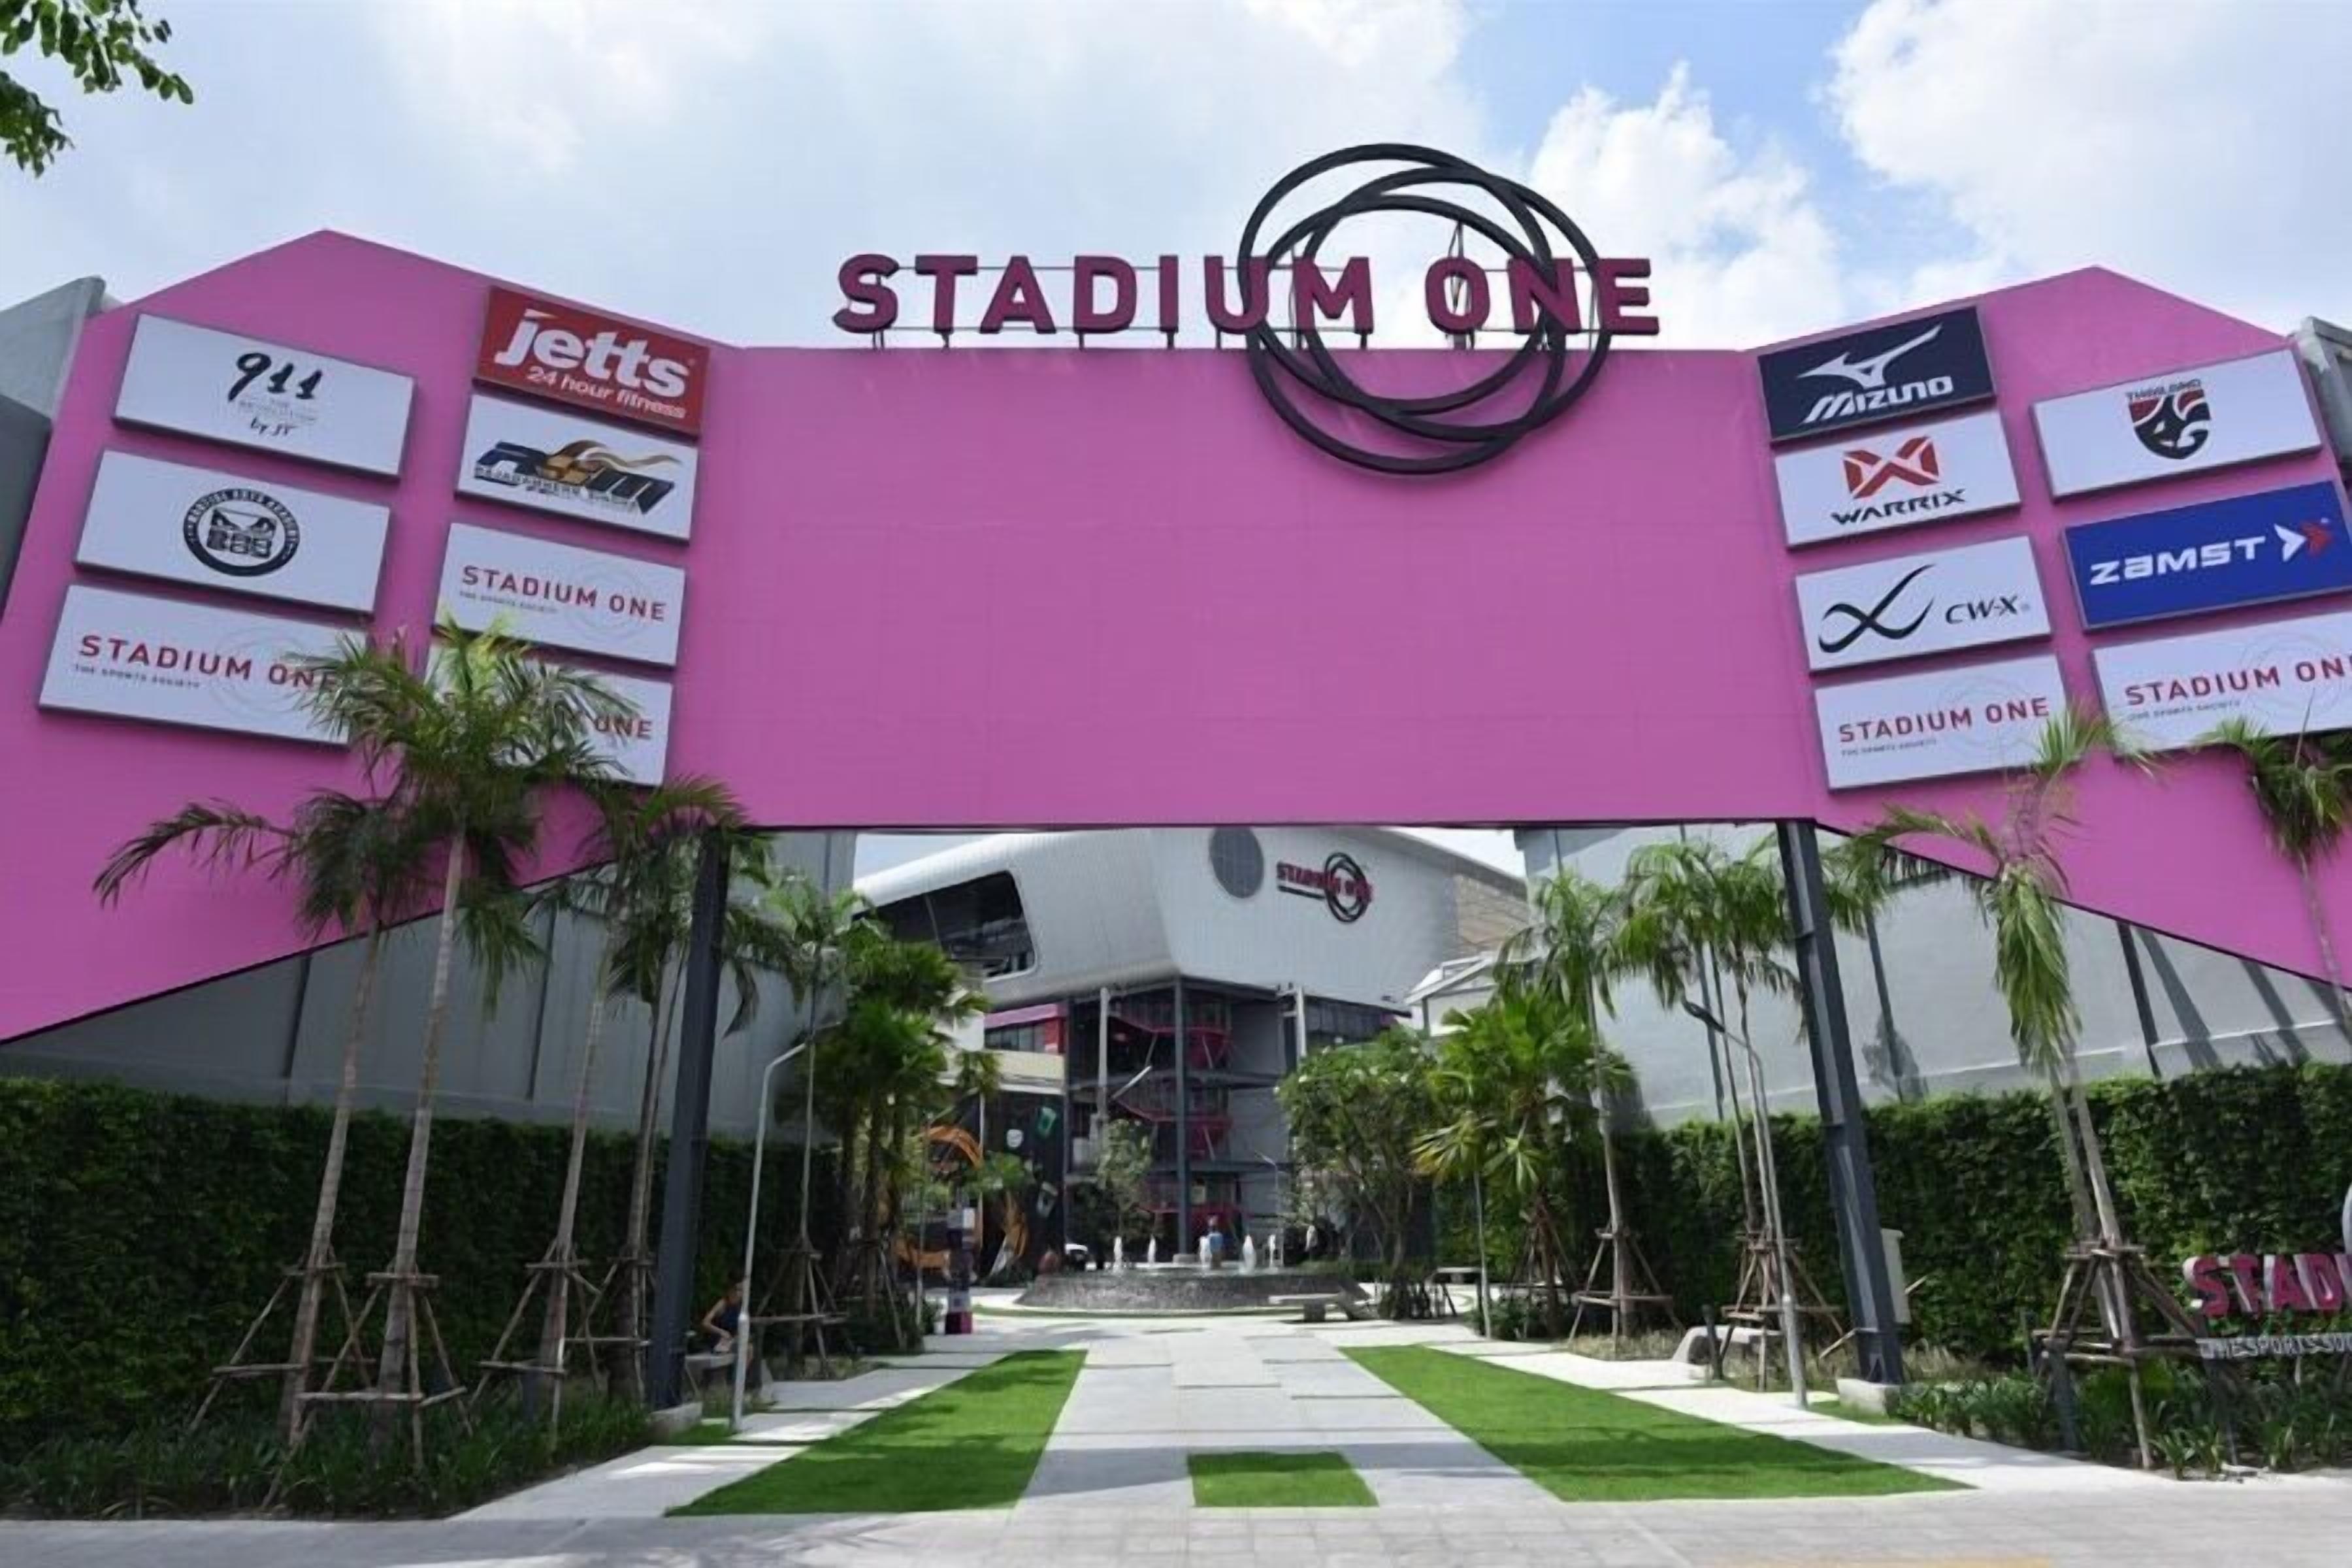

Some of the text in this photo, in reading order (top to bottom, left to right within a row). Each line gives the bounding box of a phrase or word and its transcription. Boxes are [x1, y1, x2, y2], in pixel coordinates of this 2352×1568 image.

[832, 253, 1659, 335] STADIUM ONE
[228, 352, 323, 402] 911
[495, 308, 689, 397] jetts
[526, 365, 687, 418] 24 hour fitness
[1831, 489, 1967, 525] WARRIX
[461, 564, 598, 607] STADIUM
[609, 593, 667, 621] ONE
[78, 635, 252, 681] STADIUM
[2125, 655, 2352, 706] STADIUM ON
[1839, 697, 2050, 743] STADIUM ONE
